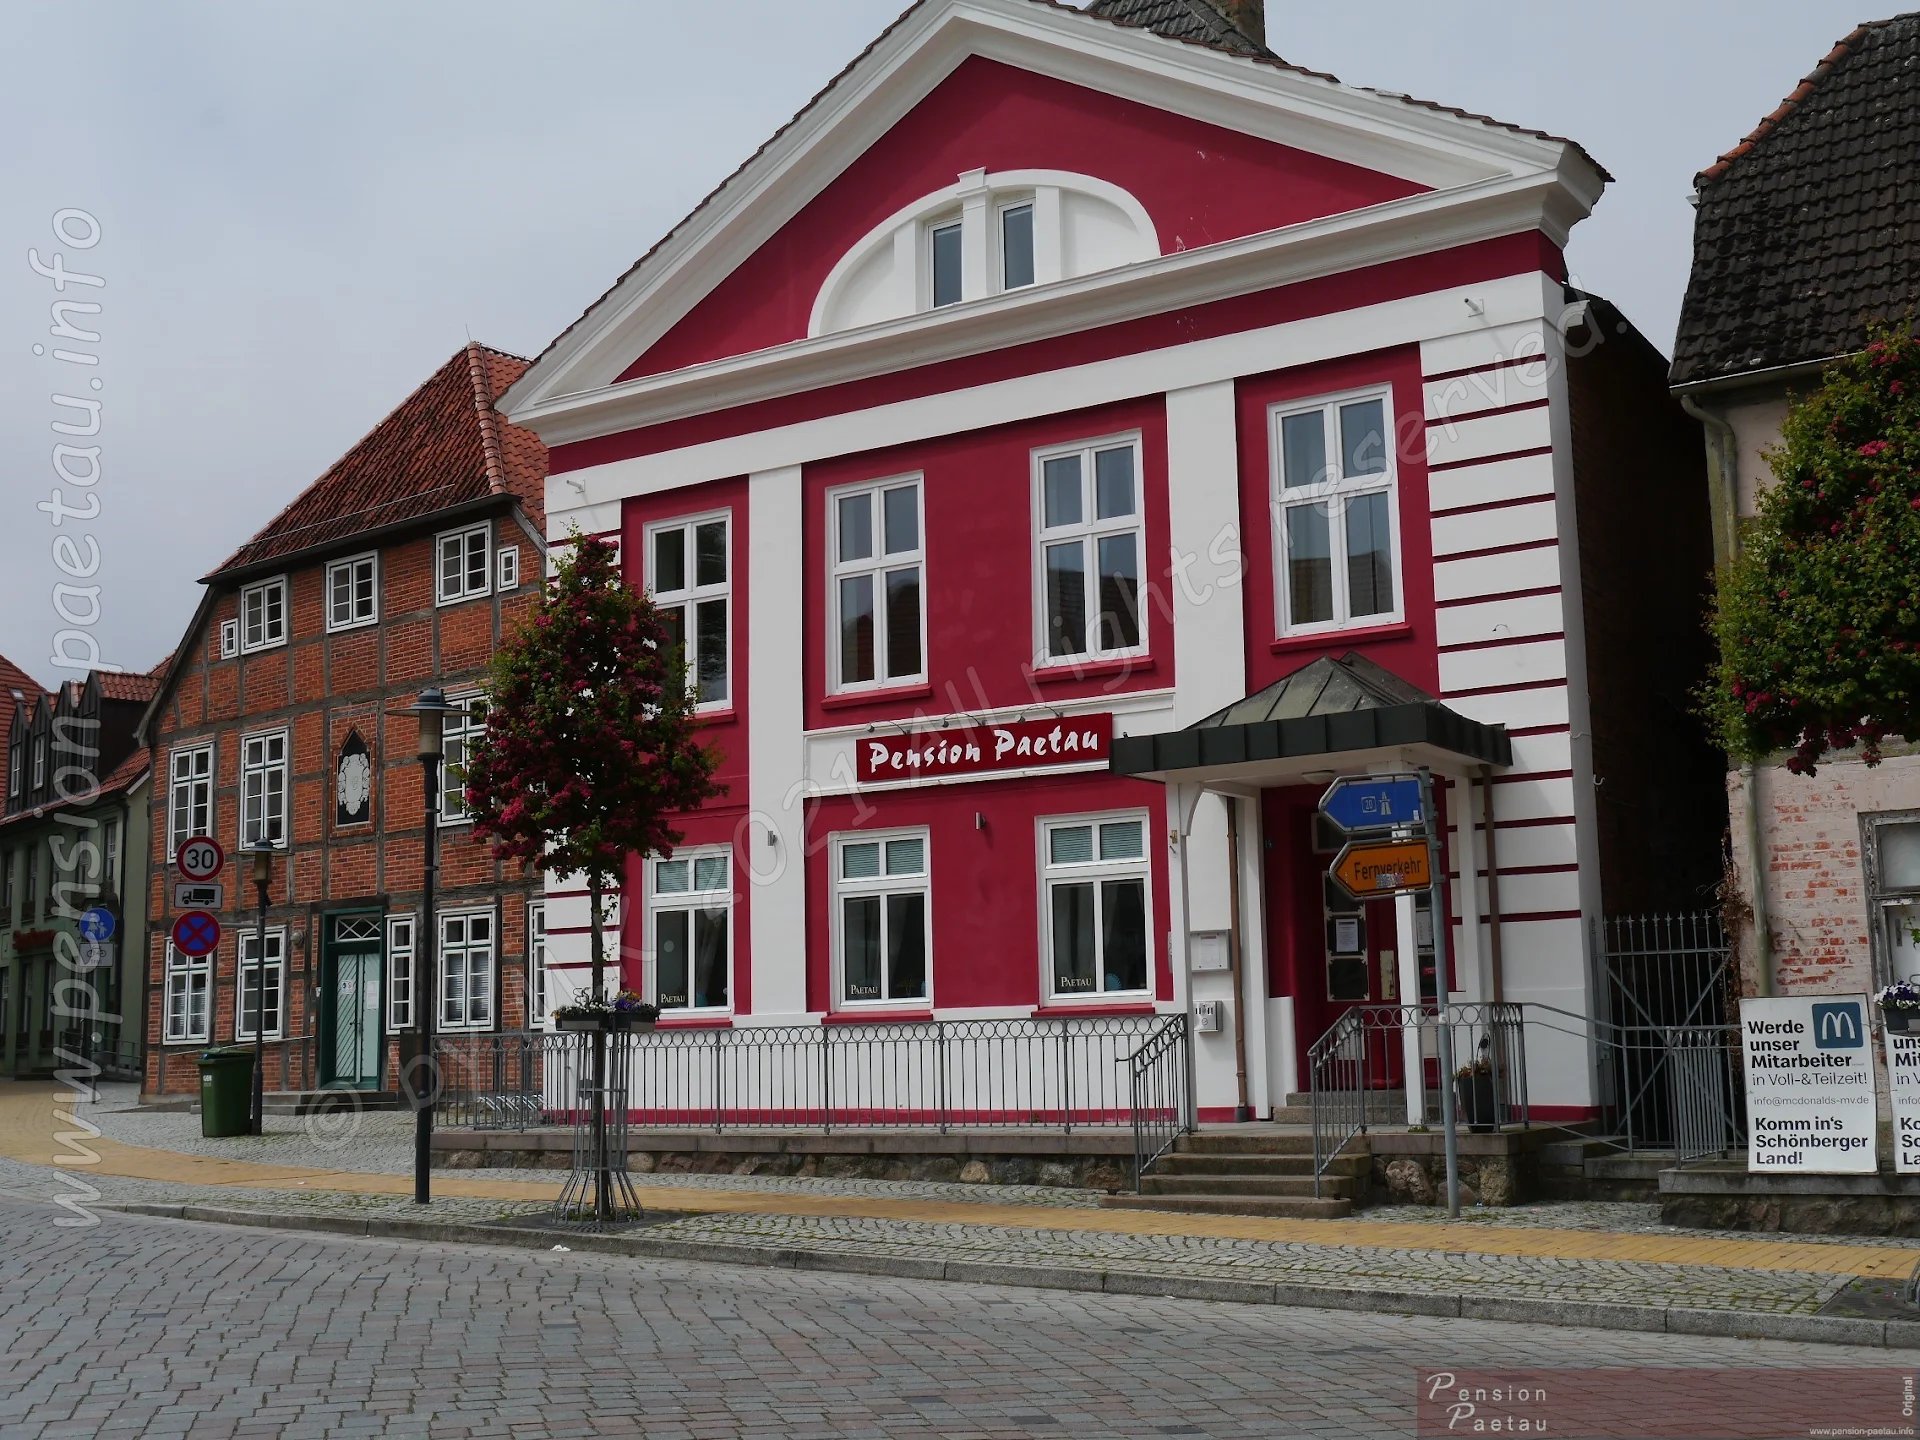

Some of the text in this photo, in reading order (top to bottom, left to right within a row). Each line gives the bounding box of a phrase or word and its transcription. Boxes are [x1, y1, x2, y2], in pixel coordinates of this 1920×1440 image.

[869, 725, 1099, 773] Pension Paetau
[187, 848, 214, 869] 30
[1354, 857, 1422, 881] Fernverkehr
[1748, 1020, 1804, 1034] Werde
[1750, 1040, 1800, 1051] unser
[1893, 1038, 1920, 1049] un
[1752, 1053, 1852, 1069] Mitarbeiter
[1752, 1073, 1765, 1085] in
[1896, 1073, 1910, 1085] in
[1754, 1096, 1869, 1106] info@mcdonalds-mv.de
[1755, 1117, 1811, 1131] Komm
[1756, 1134, 1868, 1151] Schönberger
[1756, 1151, 1803, 1164] Land!
